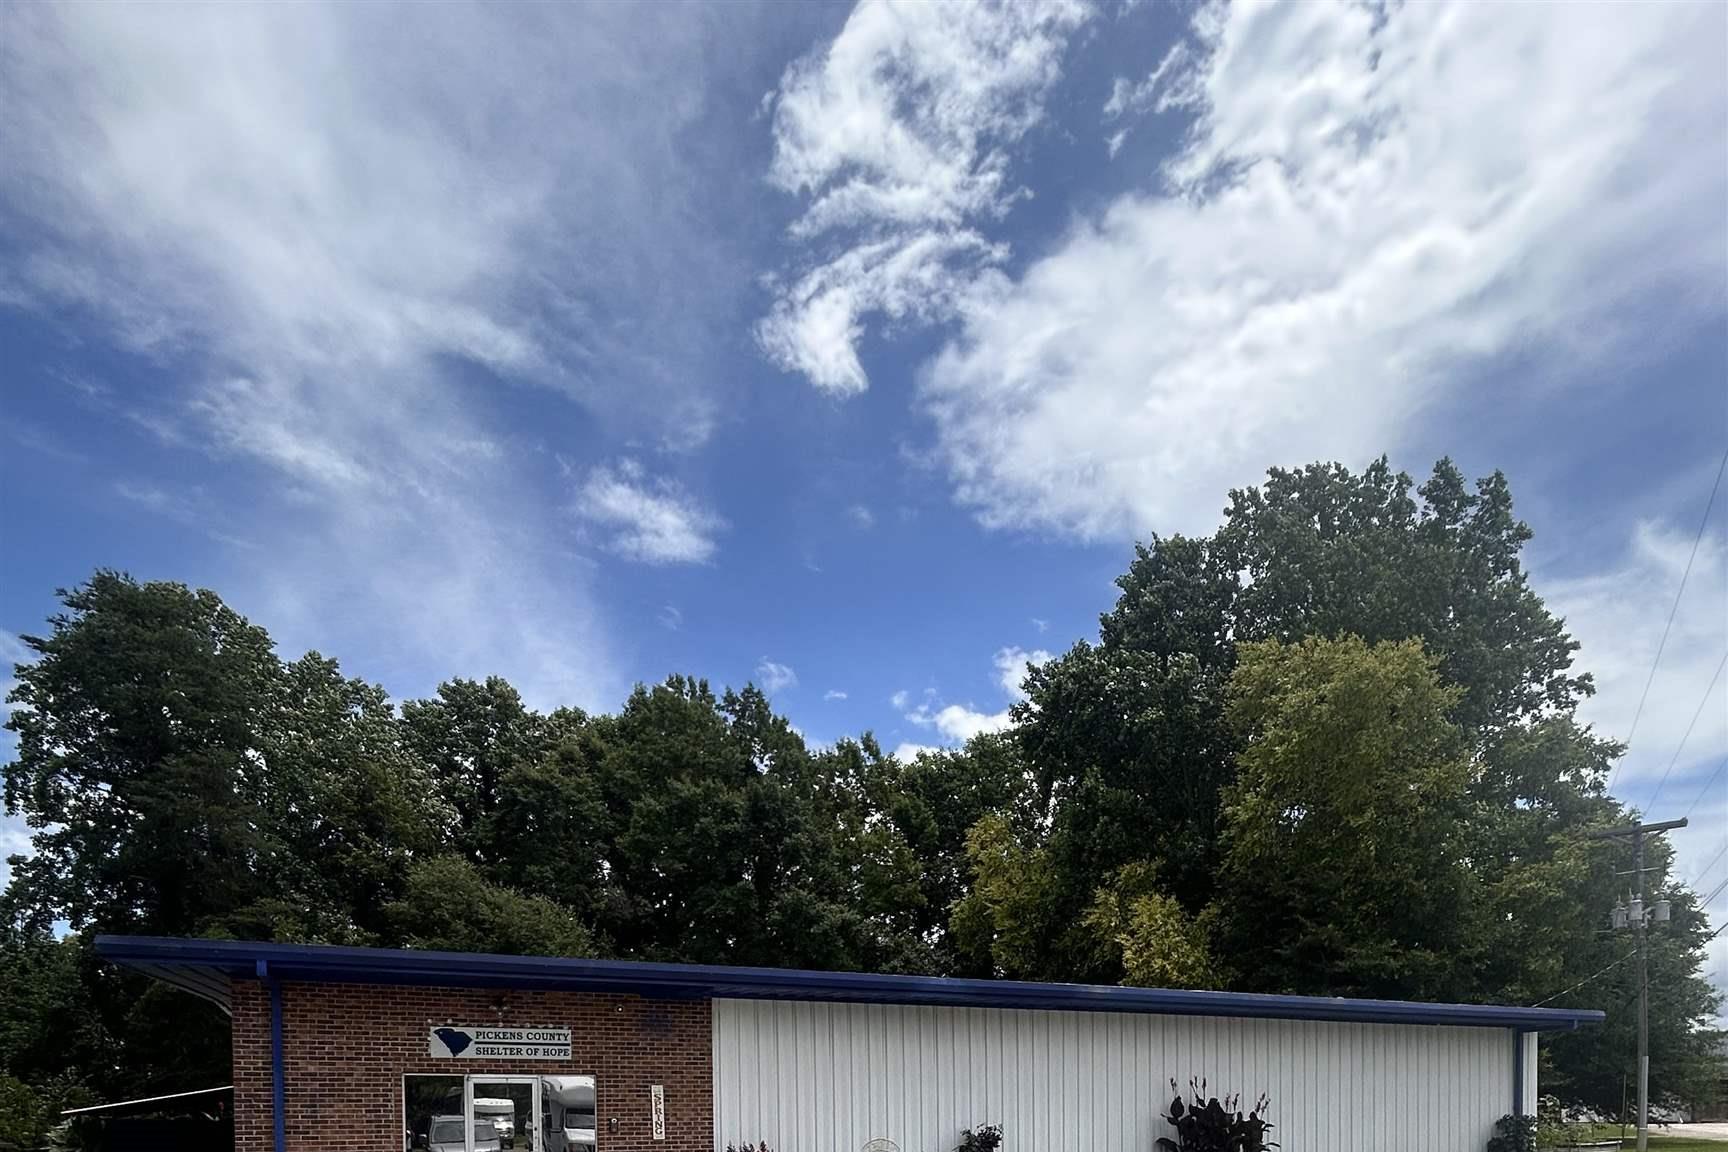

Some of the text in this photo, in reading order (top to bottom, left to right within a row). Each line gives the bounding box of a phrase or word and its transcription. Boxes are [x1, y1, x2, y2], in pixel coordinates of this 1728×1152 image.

[475, 1031, 570, 1041] PICKENS COUNTY
[475, 1047, 570, 1057] SHELTER OF HOPE
